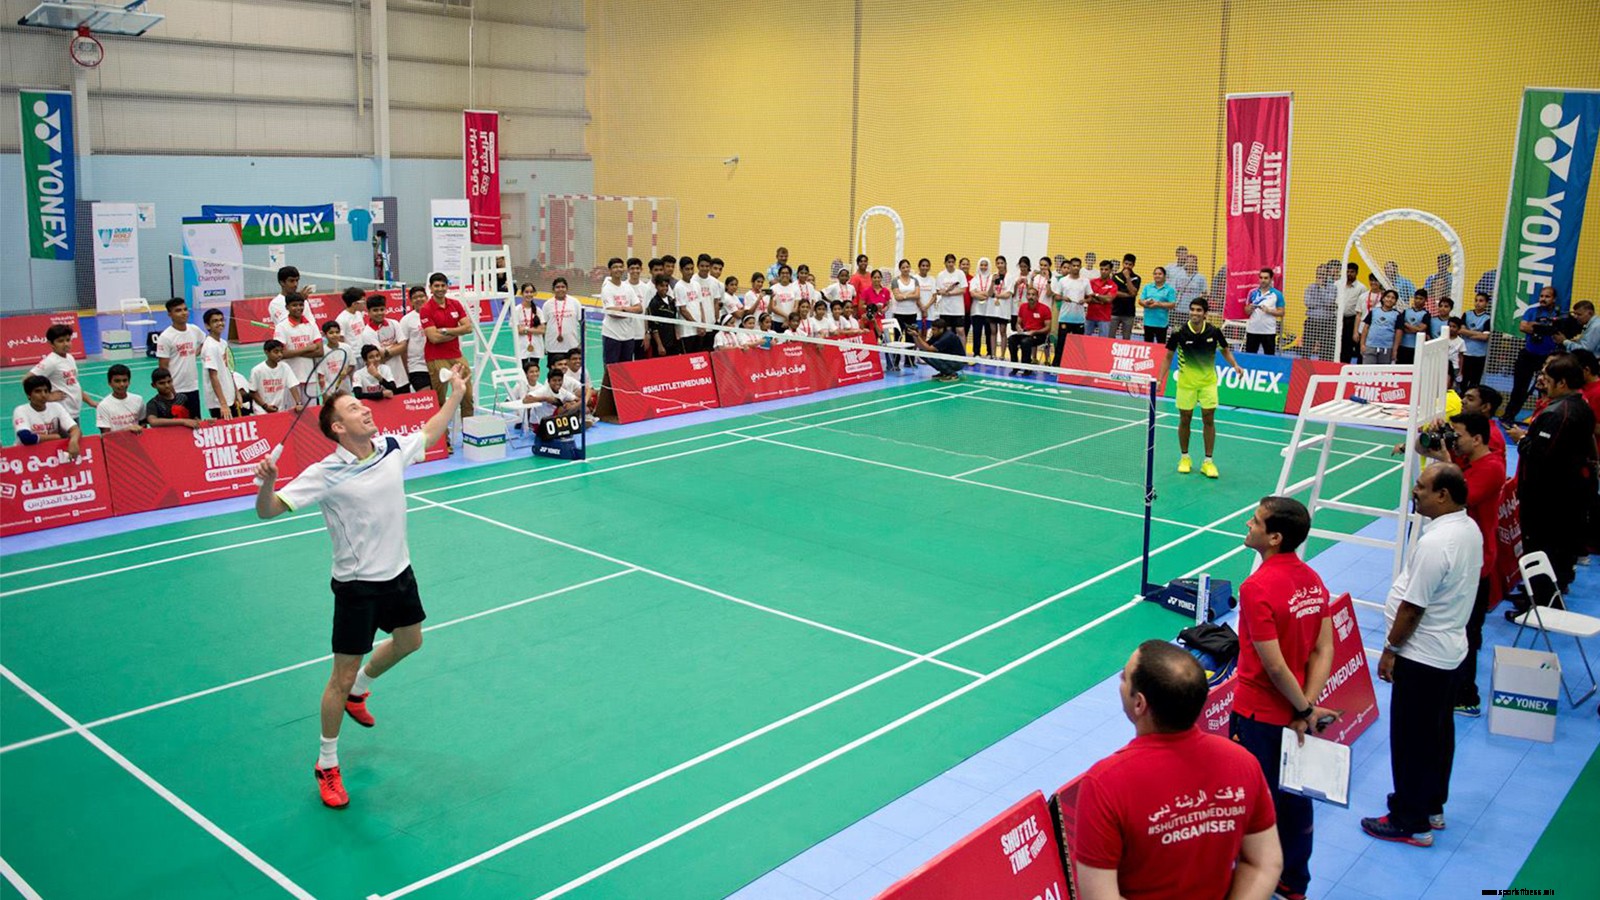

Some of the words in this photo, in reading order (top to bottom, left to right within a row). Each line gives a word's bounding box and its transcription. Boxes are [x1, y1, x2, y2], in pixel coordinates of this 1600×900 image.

[37, 159, 69, 250] YONEX
[255, 211, 326, 237] YONEX
[1111, 342, 1152, 360] SHUTTLE
[1112, 356, 1135, 371] TIME
[642, 377, 712, 394] #SHUTTLETIMEDUBAI
[1215, 365, 1285, 395] YONEX
[193, 421, 259, 448] SHUTTLE
[546, 420, 556, 435] 0
[570, 416, 579, 430] 0
[202, 445, 241, 469] TIME
[242, 440, 270, 462] DUBAI
[21, 469, 93, 495] الريشة
[1516, 697, 1549, 712] YONEX
[1147, 805, 1247, 835] #SHUTTLETIMEDUBAI
[1161, 819, 1237, 845] ORGANISER
[1001, 815, 1039, 856] SHUTTLE
[1009, 844, 1033, 875] TIME
